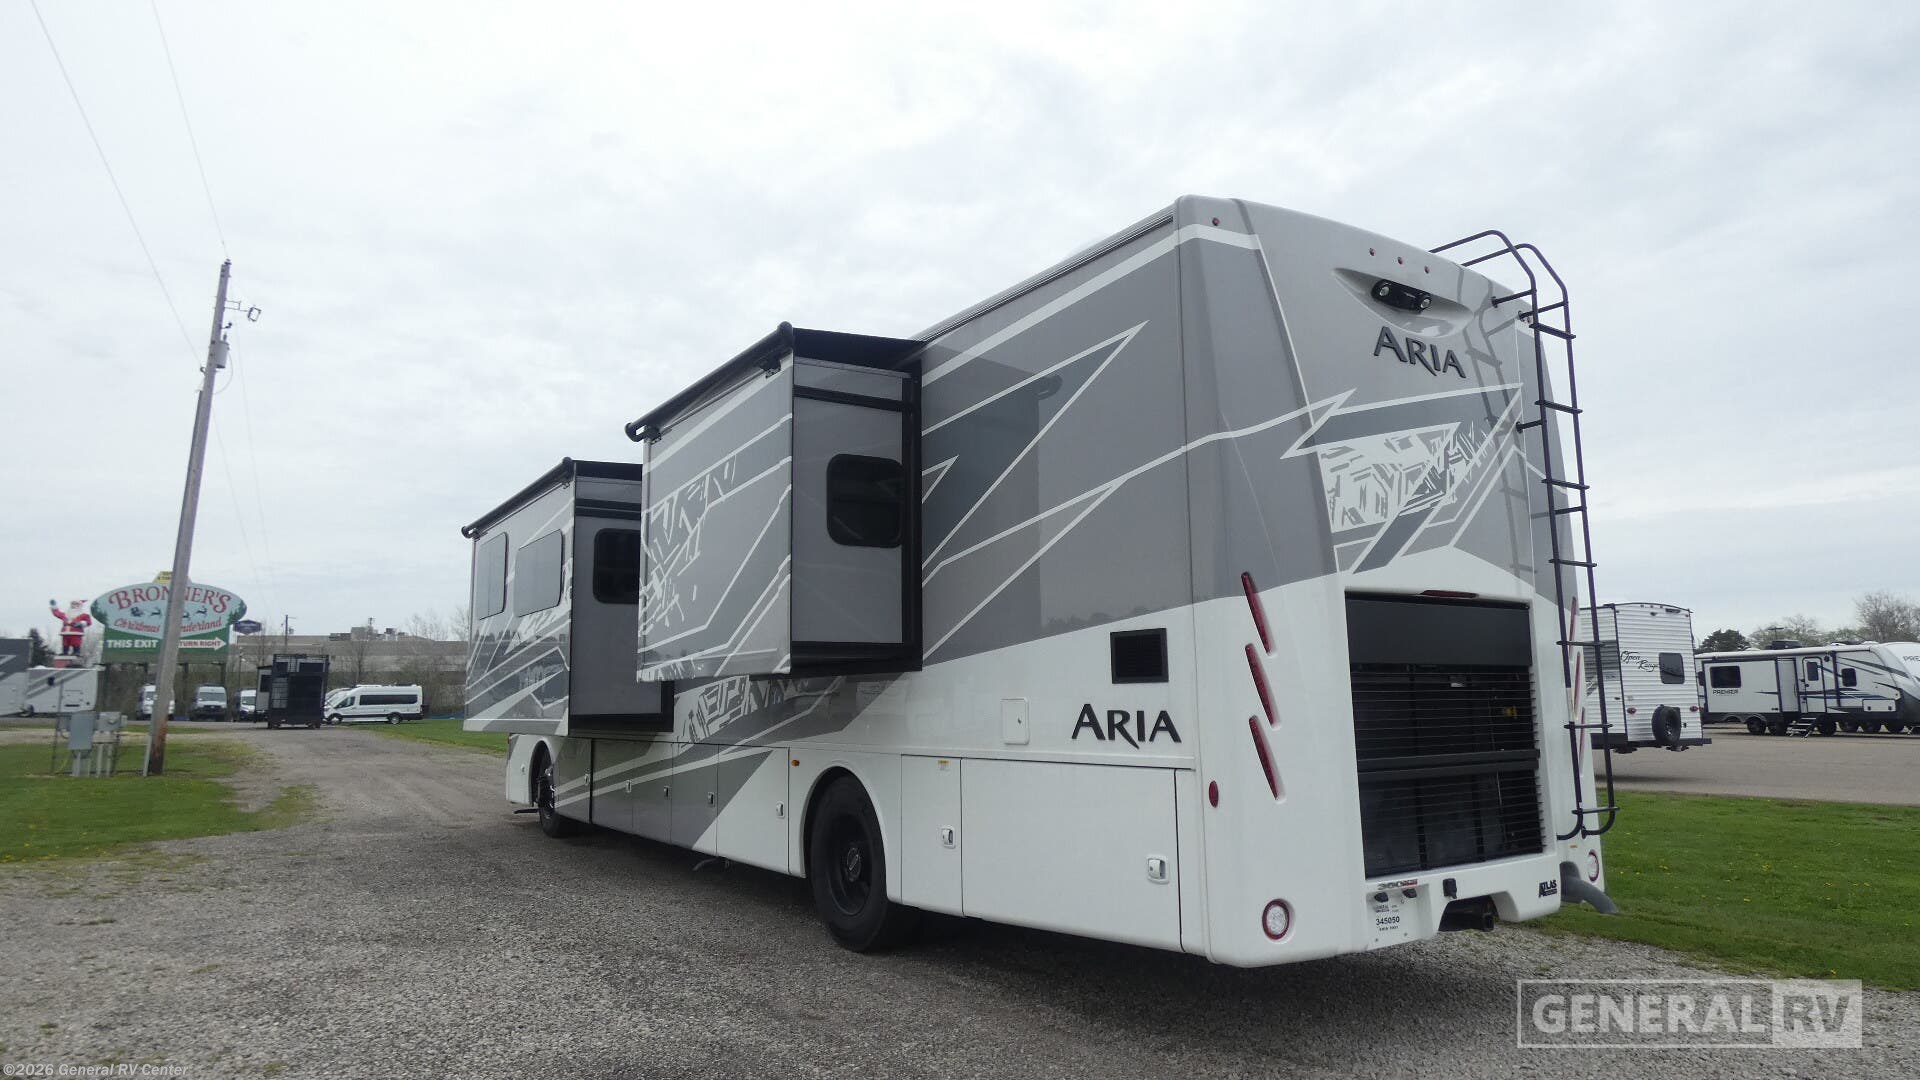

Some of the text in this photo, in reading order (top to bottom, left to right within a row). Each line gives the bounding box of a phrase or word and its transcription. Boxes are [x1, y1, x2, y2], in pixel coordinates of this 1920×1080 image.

[1374, 326, 1466, 378] ARIA
[180, 617, 223, 632] nderland
[106, 639, 159, 649] THIS EXIT
[180, 640, 222, 648] TURN RIGHT
[1620, 650, 1641, 664] Open
[1636, 659, 1660, 673] Range
[1071, 703, 1182, 750] ARIA
[1538, 879, 1557, 898] ATLAS
[1375, 915, 1401, 926] 345050
